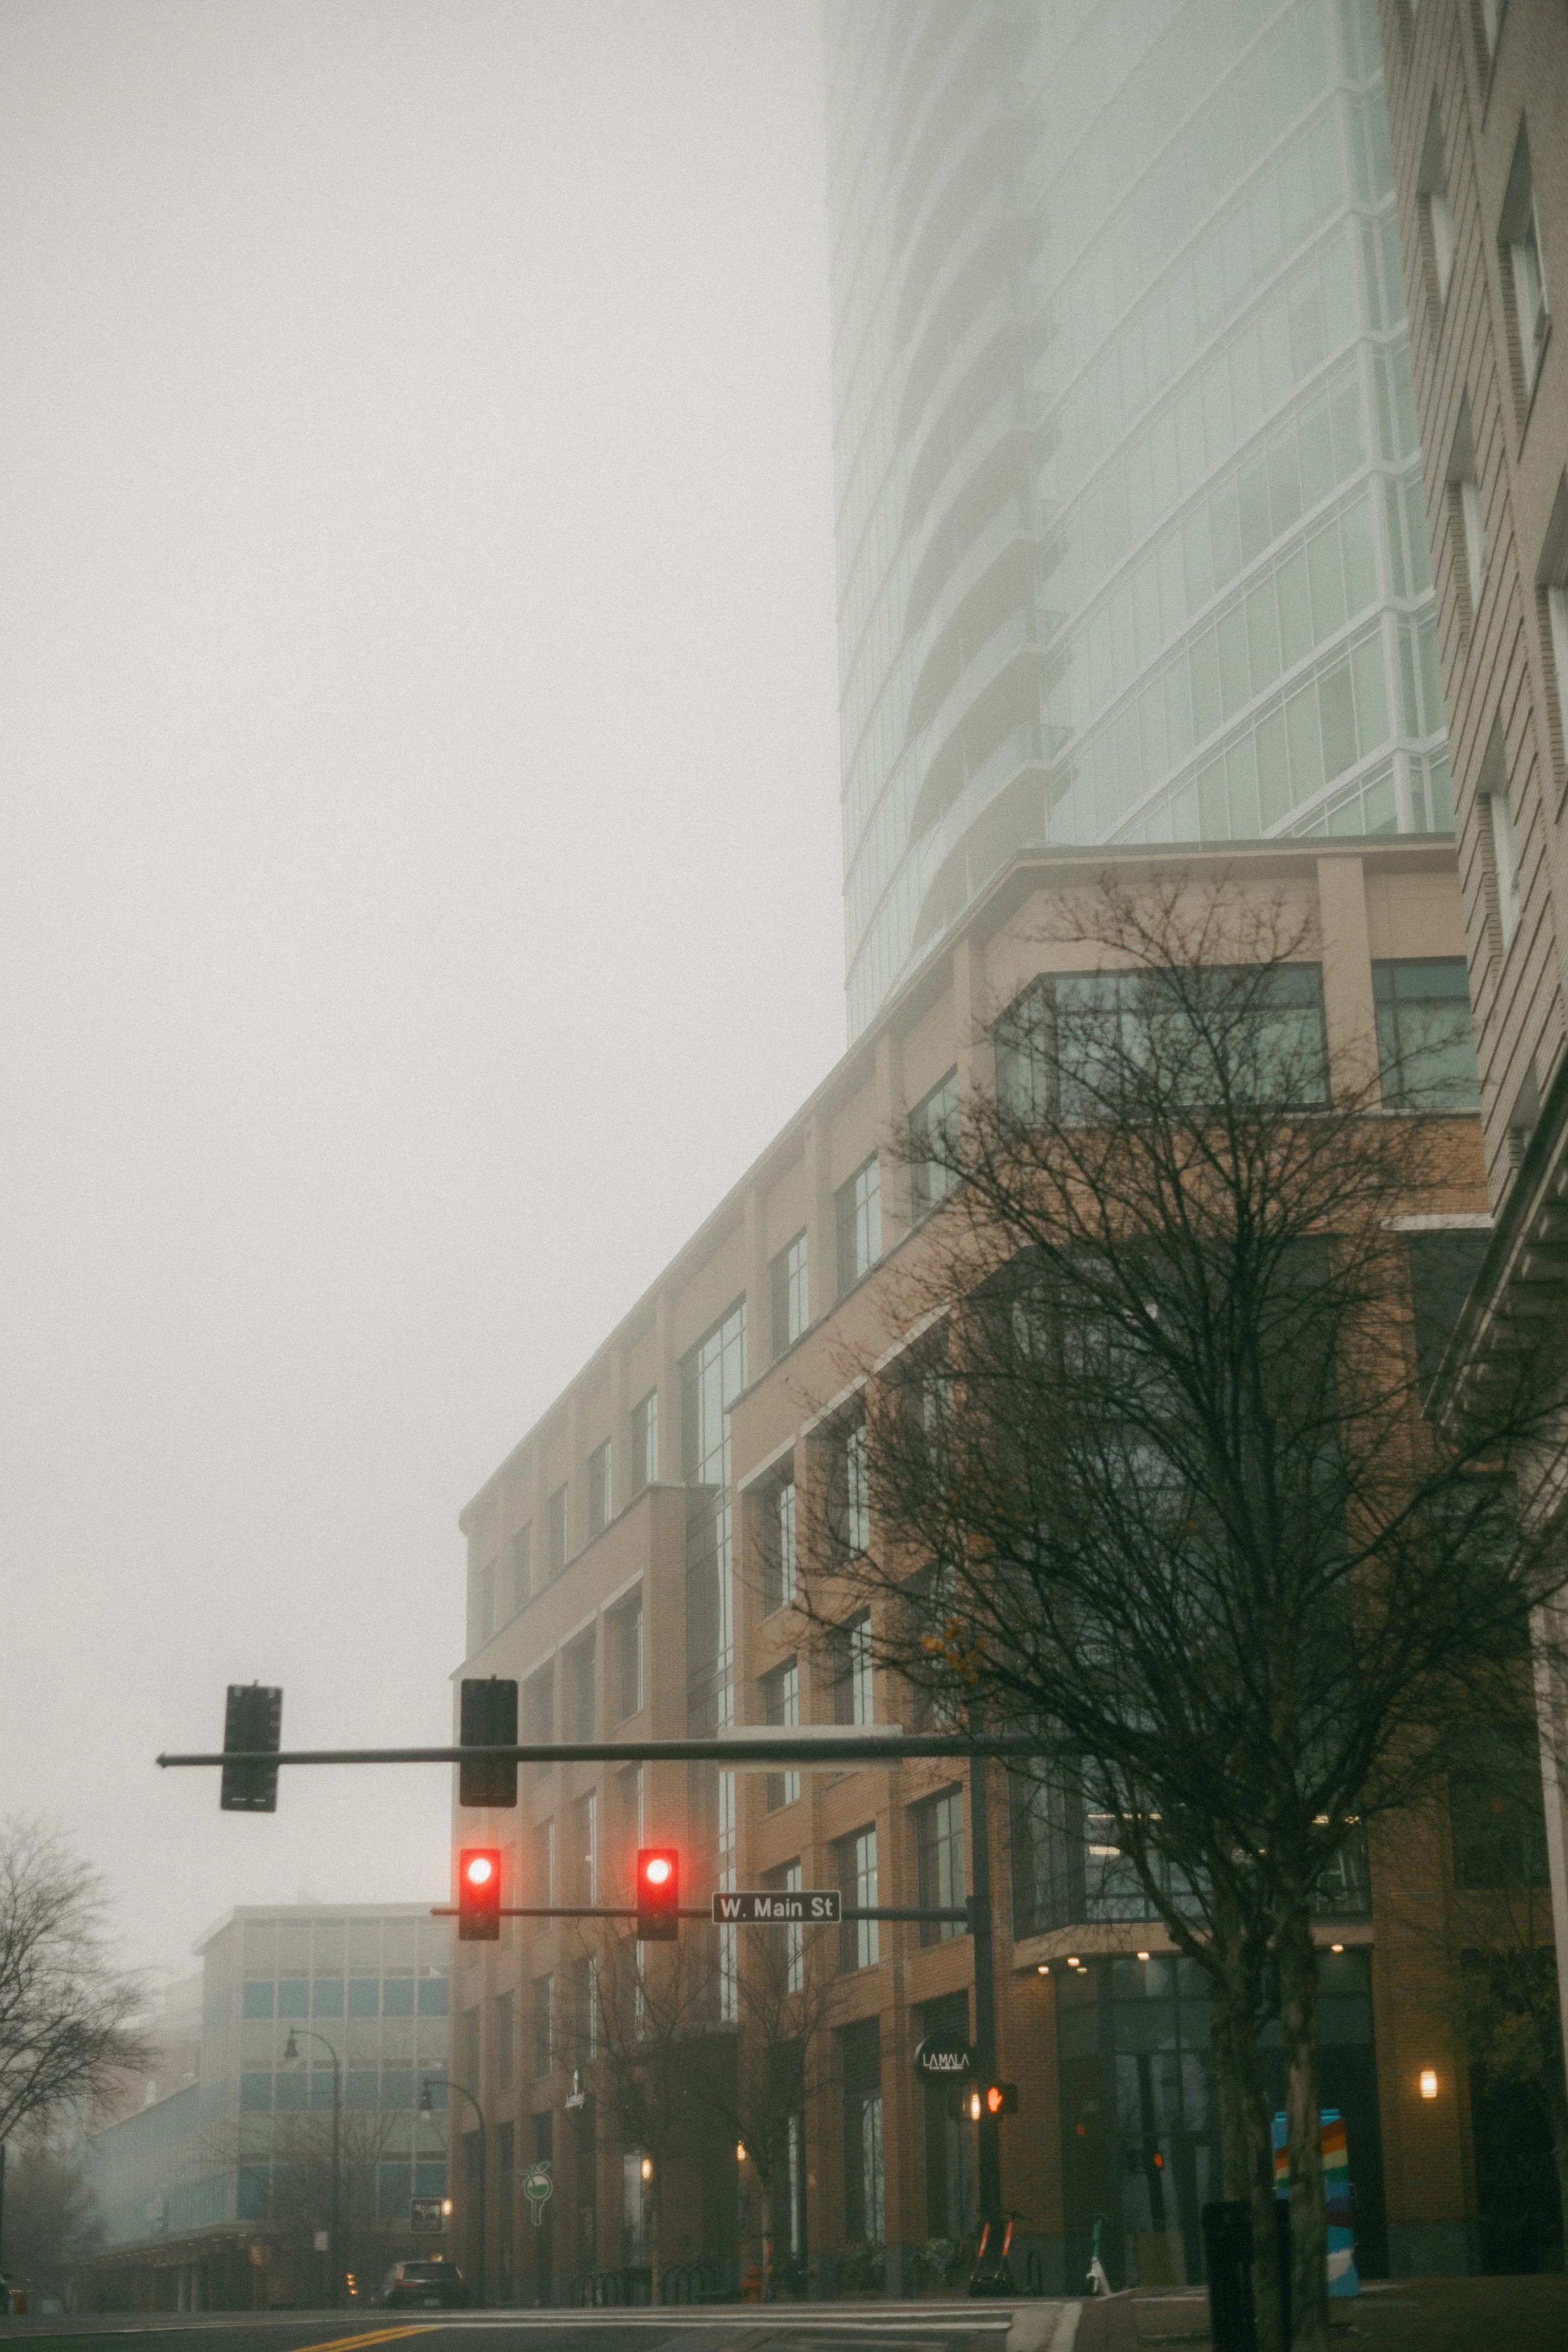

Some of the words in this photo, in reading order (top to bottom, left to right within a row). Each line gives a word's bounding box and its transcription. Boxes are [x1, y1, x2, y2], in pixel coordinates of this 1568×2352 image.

[721, 1898, 746, 1917] W.
[755, 1898, 803, 1917] Main
[811, 1897, 833, 1917] St
